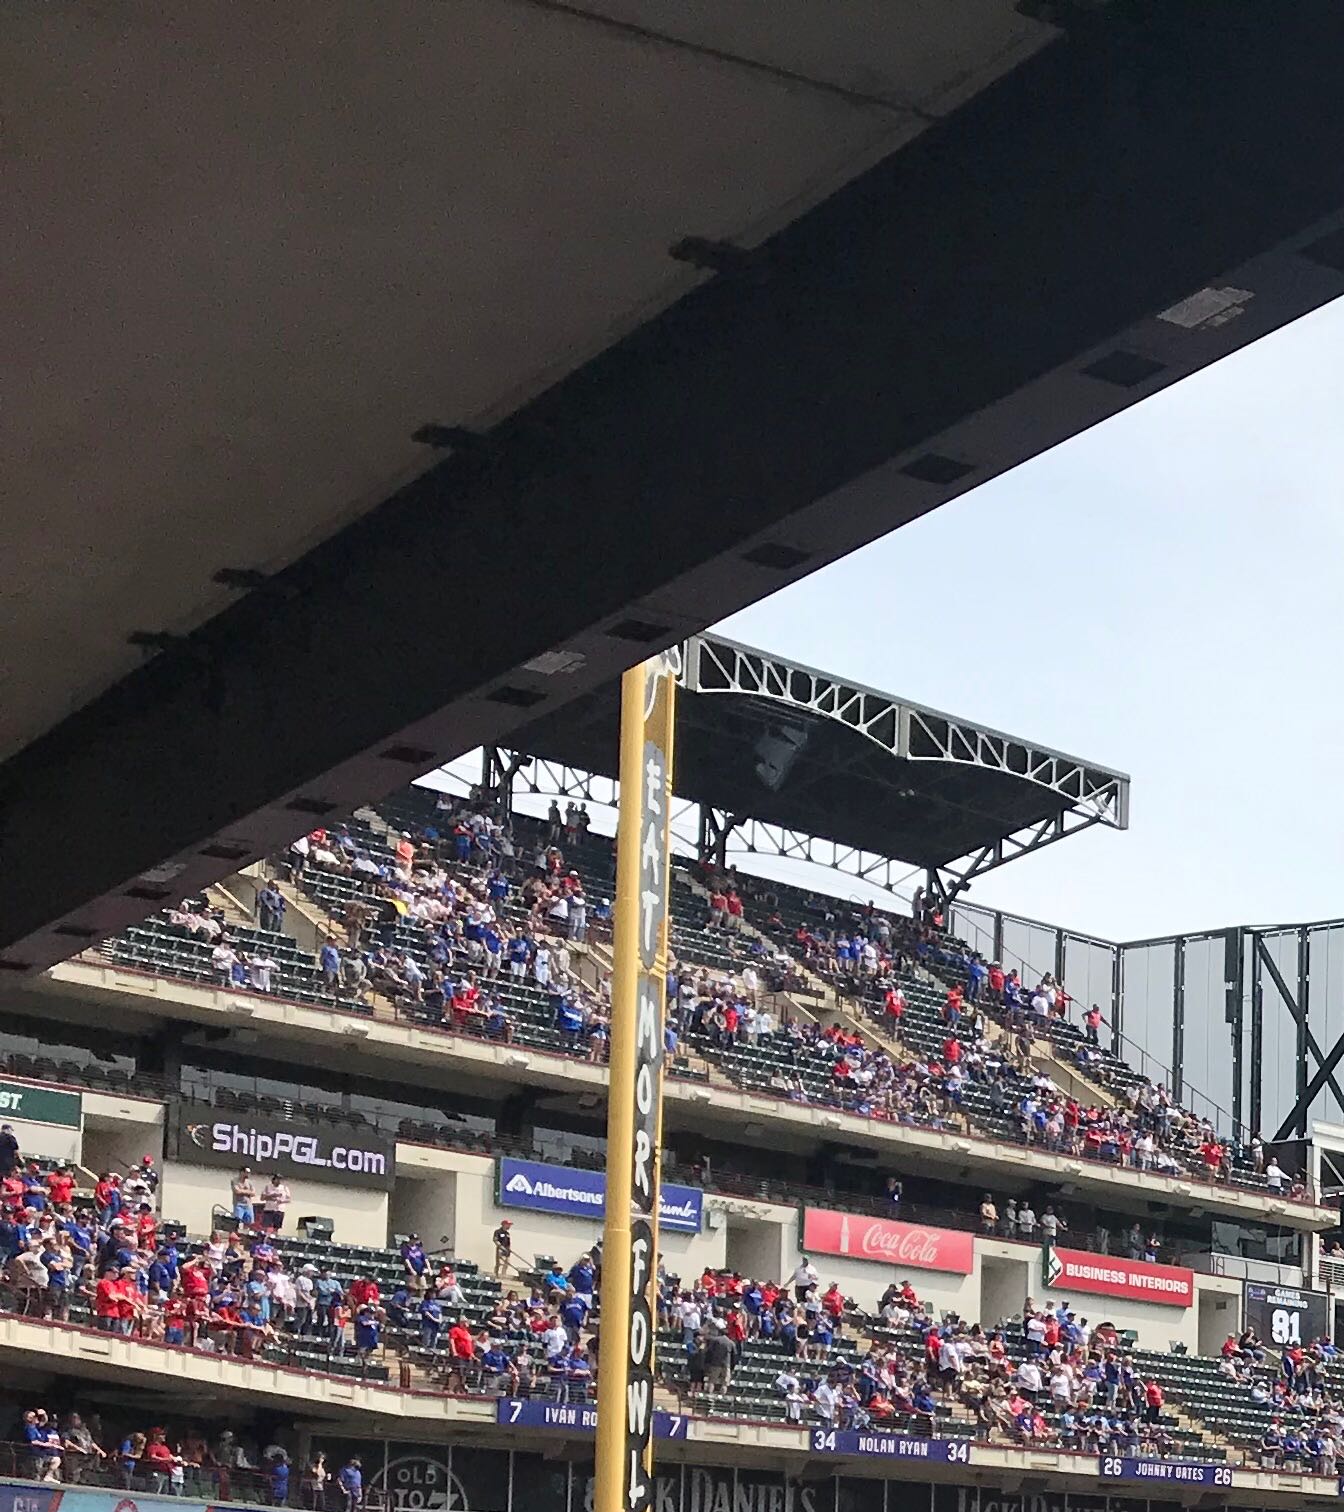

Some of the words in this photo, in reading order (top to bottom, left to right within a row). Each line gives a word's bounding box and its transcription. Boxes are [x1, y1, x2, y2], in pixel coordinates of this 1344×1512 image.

[212, 1122, 386, 1176] ShipPGL.com
[533, 1181, 603, 1205] Albertsons
[862, 1223, 940, 1265] Coca-Cola
[1066, 1263, 1127, 1285] BUSINESS
[1128, 1273, 1190, 1295] INTERIORS
[1271, 1309, 1300, 1345] 81
[509, 1402, 523, 1423] 7
[669, 1416, 681, 1437] 7
[814, 1430, 837, 1452] 34
[858, 1436, 896, 1454] NOLAN
[899, 1440, 929, 1457] RYAN
[946, 1442, 969, 1463] 34
[396, 1466, 438, 1486] OLD
[1104, 1457, 1123, 1477] 26
[1135, 1461, 1173, 1480] JOHNNY
[1174, 1465, 1204, 1482] OATES
[1213, 1467, 1232, 1486] 26
